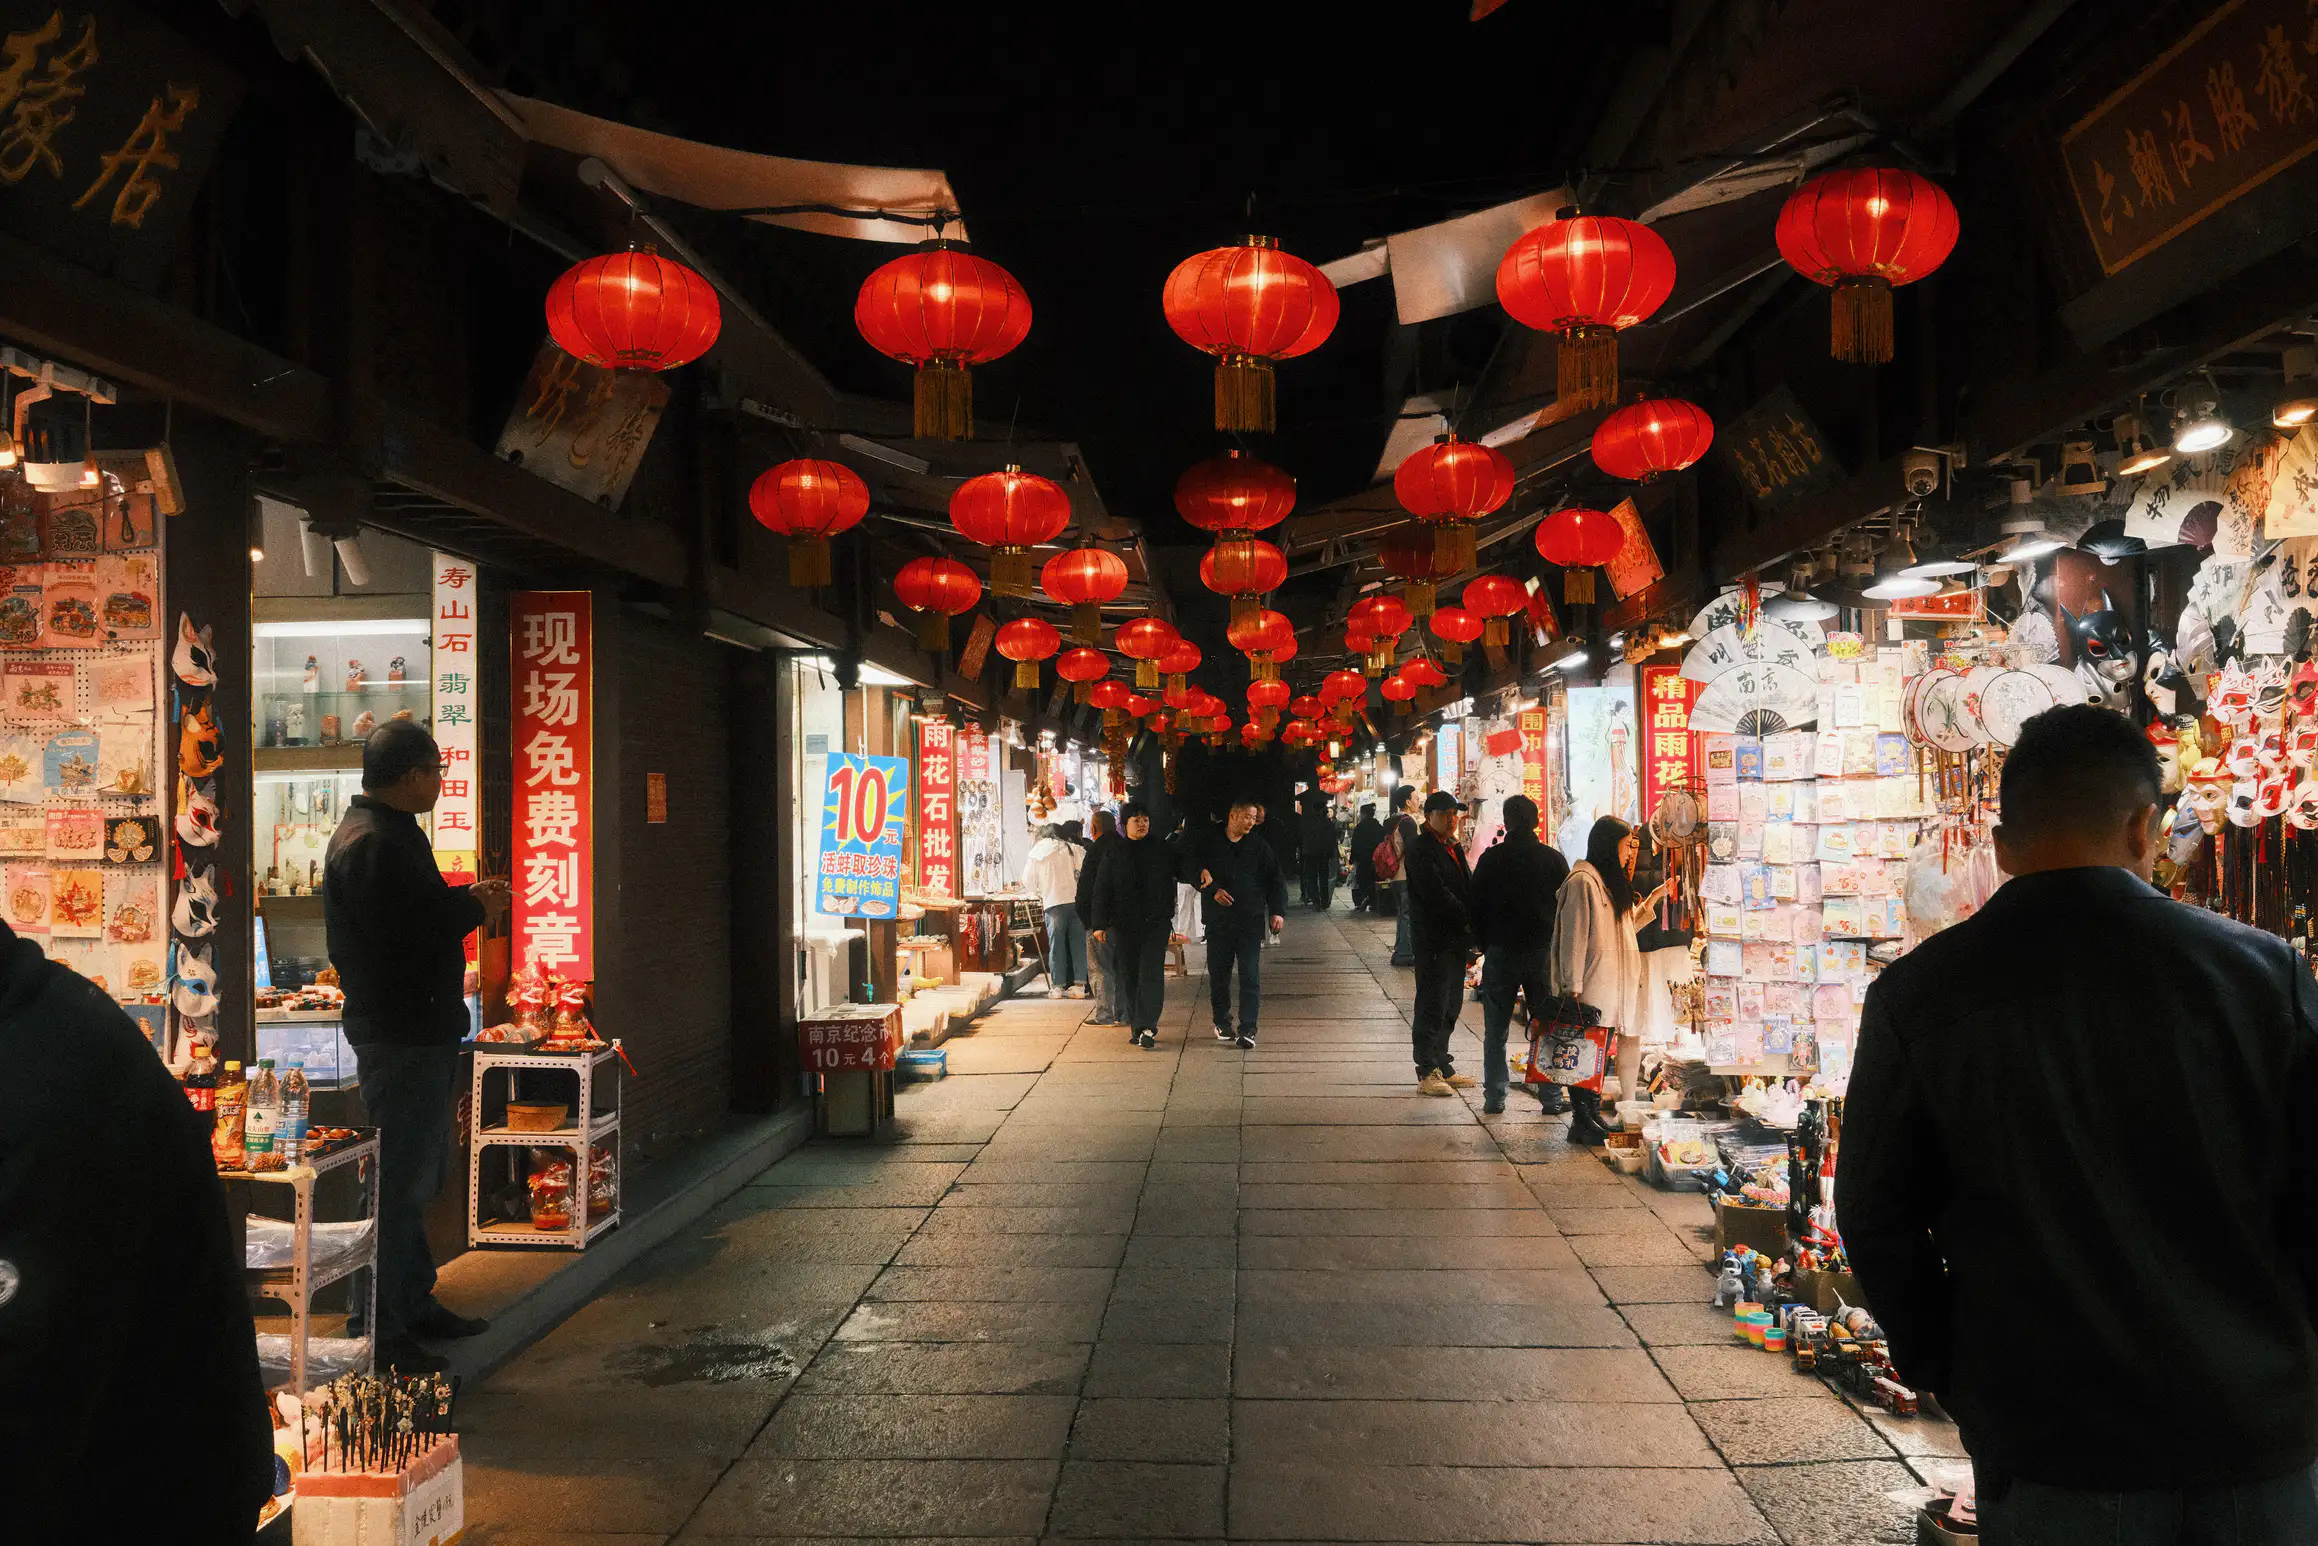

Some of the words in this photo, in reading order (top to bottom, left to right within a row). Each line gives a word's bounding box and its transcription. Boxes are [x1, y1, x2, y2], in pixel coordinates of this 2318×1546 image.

[438, 566, 473, 654] 寿山石
[438, 672, 472, 727] 翡翠
[1736, 667, 1778, 694] 南京
[439, 745, 473, 832] 和田玉
[522, 611, 582, 972] 现场免费刻章
[922, 720, 951, 896] 雨花石批发
[821, 851, 898, 879] 活蚌取珍珠
[821, 877, 895, 897] 免费制作饰品
[808, 1024, 892, 1045] 南京纪念币
